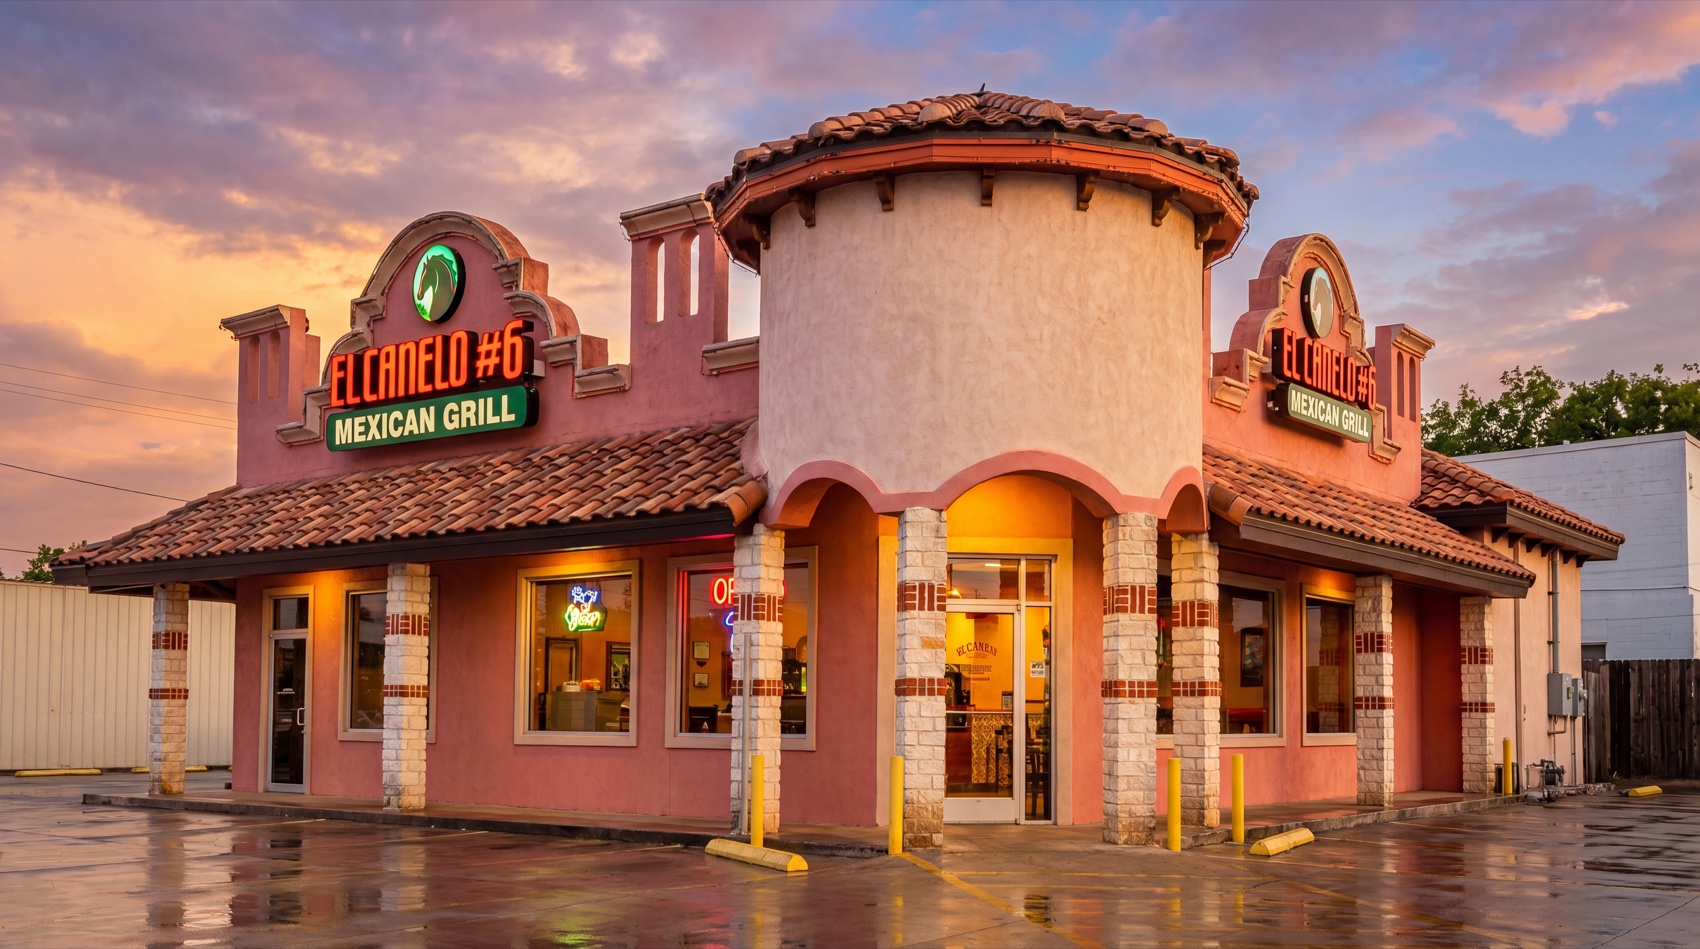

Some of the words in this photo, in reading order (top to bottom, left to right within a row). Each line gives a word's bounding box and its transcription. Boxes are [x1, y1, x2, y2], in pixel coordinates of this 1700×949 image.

[330, 353, 361, 407] EL
[363, 330, 468, 402] CANELO
[475, 319, 524, 380] #6
[1283, 327, 1300, 381] EL
[1304, 338, 1356, 402] CANELO
[1357, 364, 1376, 410] #6
[335, 406, 436, 445] MEXICAN
[443, 394, 516, 430] GRILL
[1291, 389, 1340, 427] MEXICAN
[1341, 409, 1369, 437] GRILL
